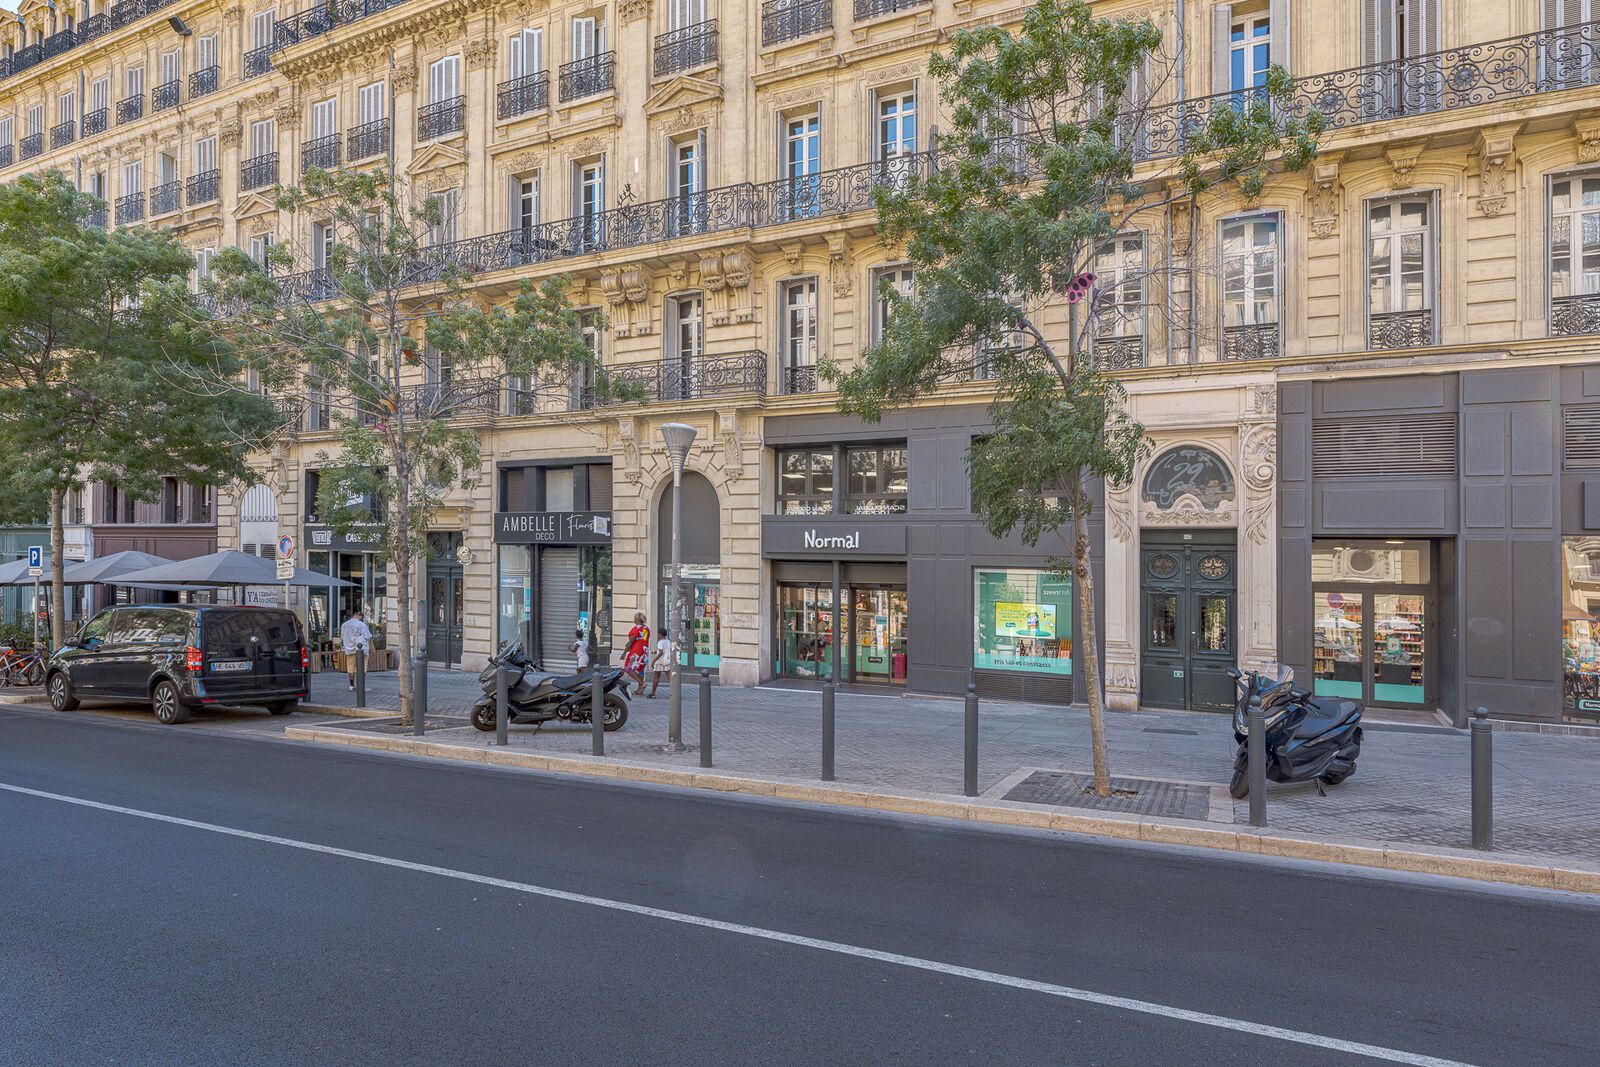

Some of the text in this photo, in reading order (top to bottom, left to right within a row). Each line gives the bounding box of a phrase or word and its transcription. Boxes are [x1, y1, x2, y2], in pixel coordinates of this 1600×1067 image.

[1167, 462, 1205, 490] 29
[503, 516, 555, 532] AMBELLE
[535, 532, 555, 541] DECO
[804, 529, 860, 549] Normal
[32, 550, 38, 564] P
